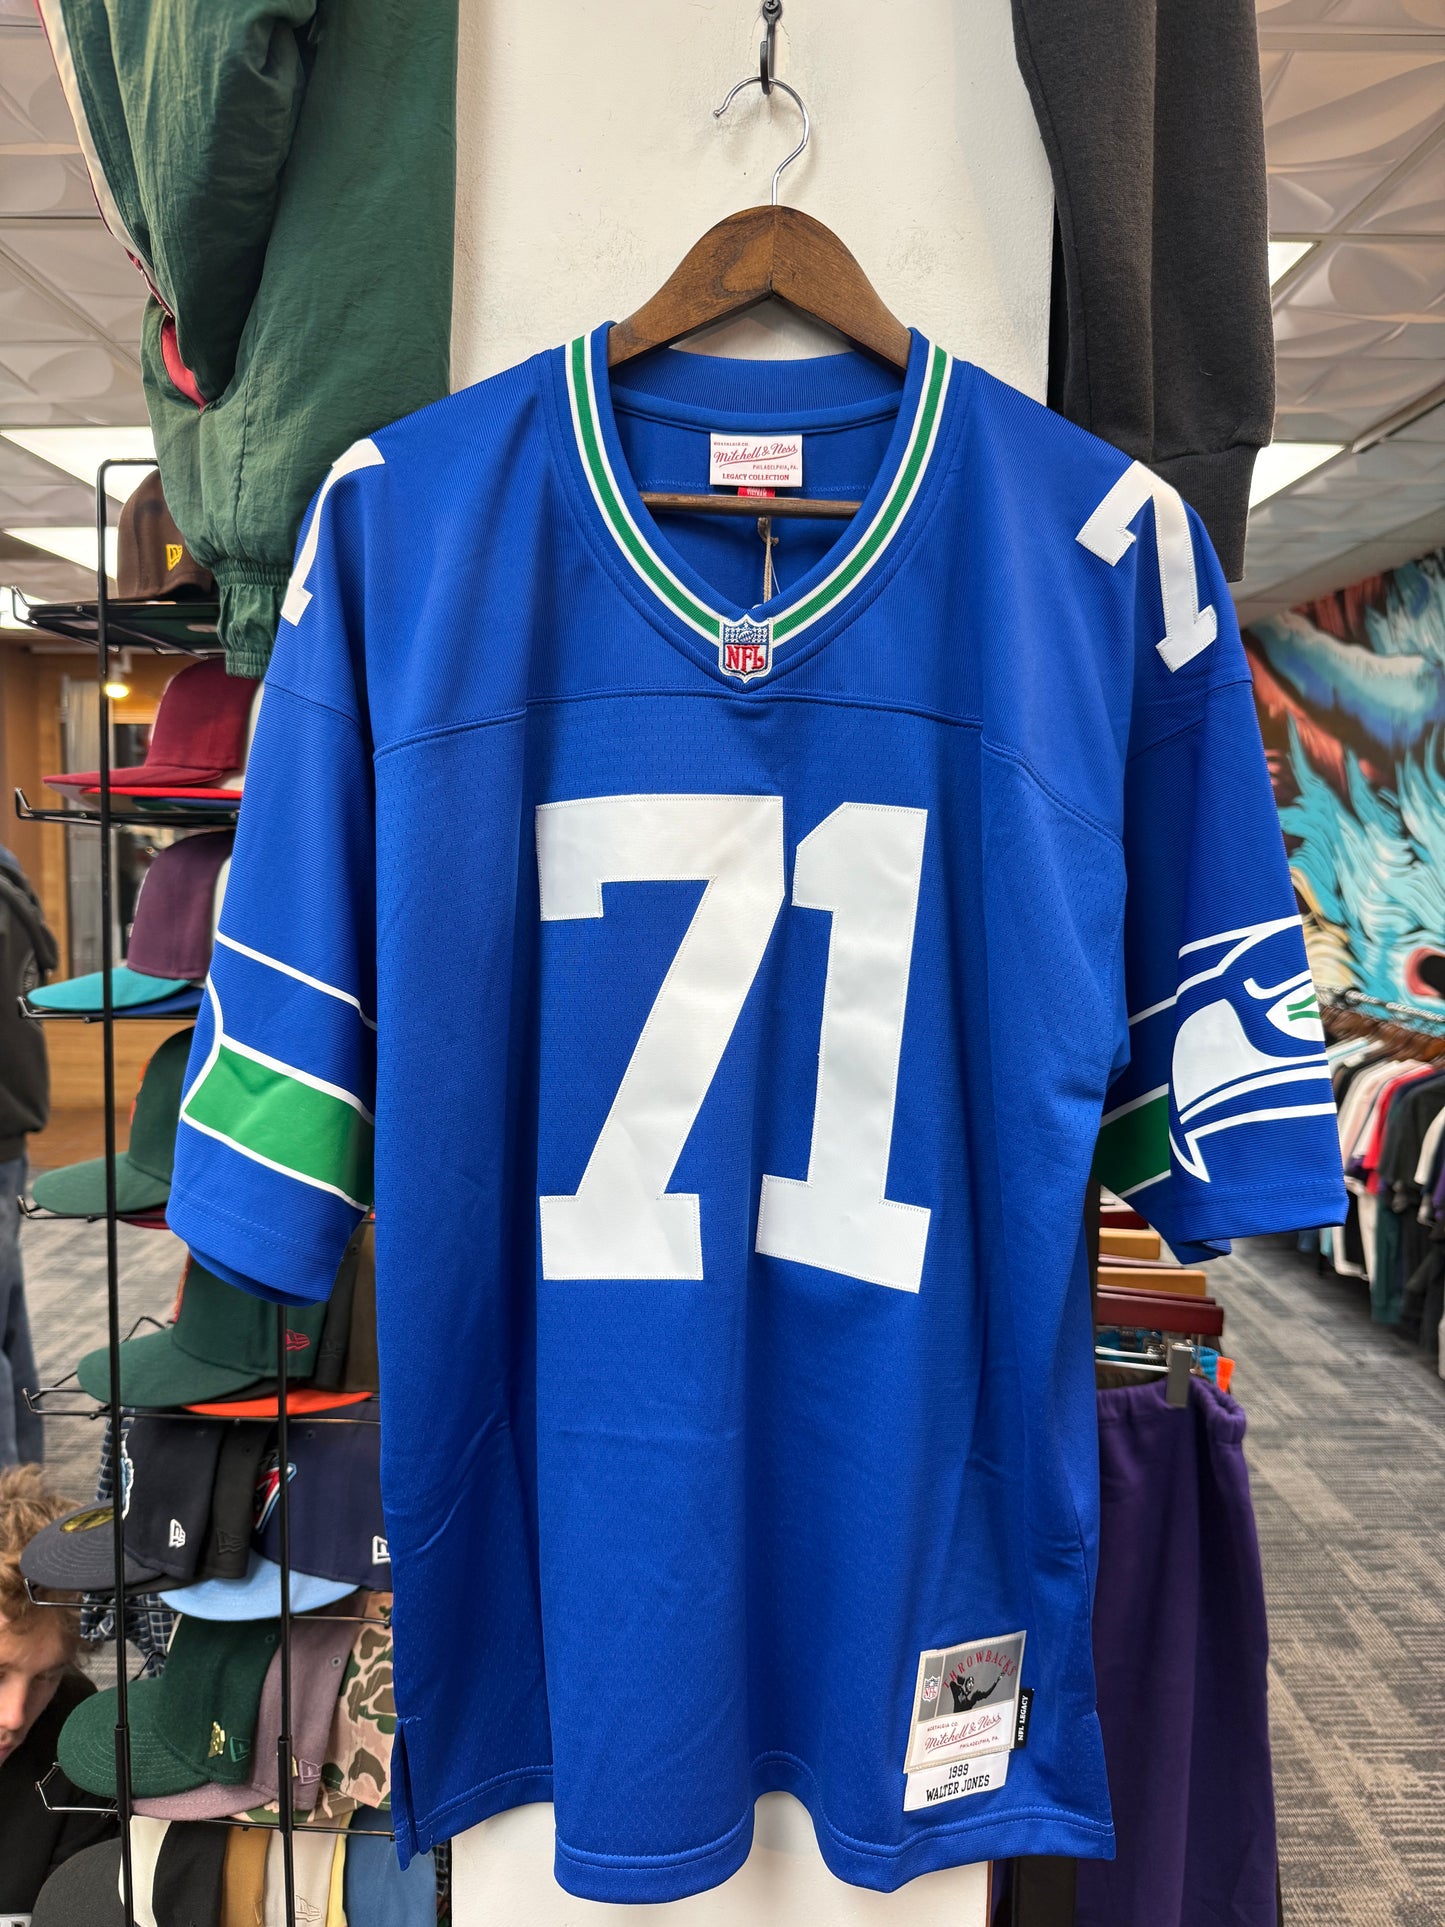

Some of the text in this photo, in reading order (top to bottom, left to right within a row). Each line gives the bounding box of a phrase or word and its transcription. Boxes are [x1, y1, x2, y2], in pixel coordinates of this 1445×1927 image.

[713, 442, 798, 463] Mitchell & Ness
[722, 472, 790, 481] LEGACY COLLECTION
[726, 644, 765, 673] NFL
[535, 793, 932, 1295] 71
[942, 1649, 1017, 1688] THROWBACKS
[1019, 1695, 1029, 1723] LEGACY
[925, 1714, 1002, 1750] Mitchell & Ness
[948, 1763, 969, 1780] 1999
[926, 1774, 990, 1802] WALTER JONES
